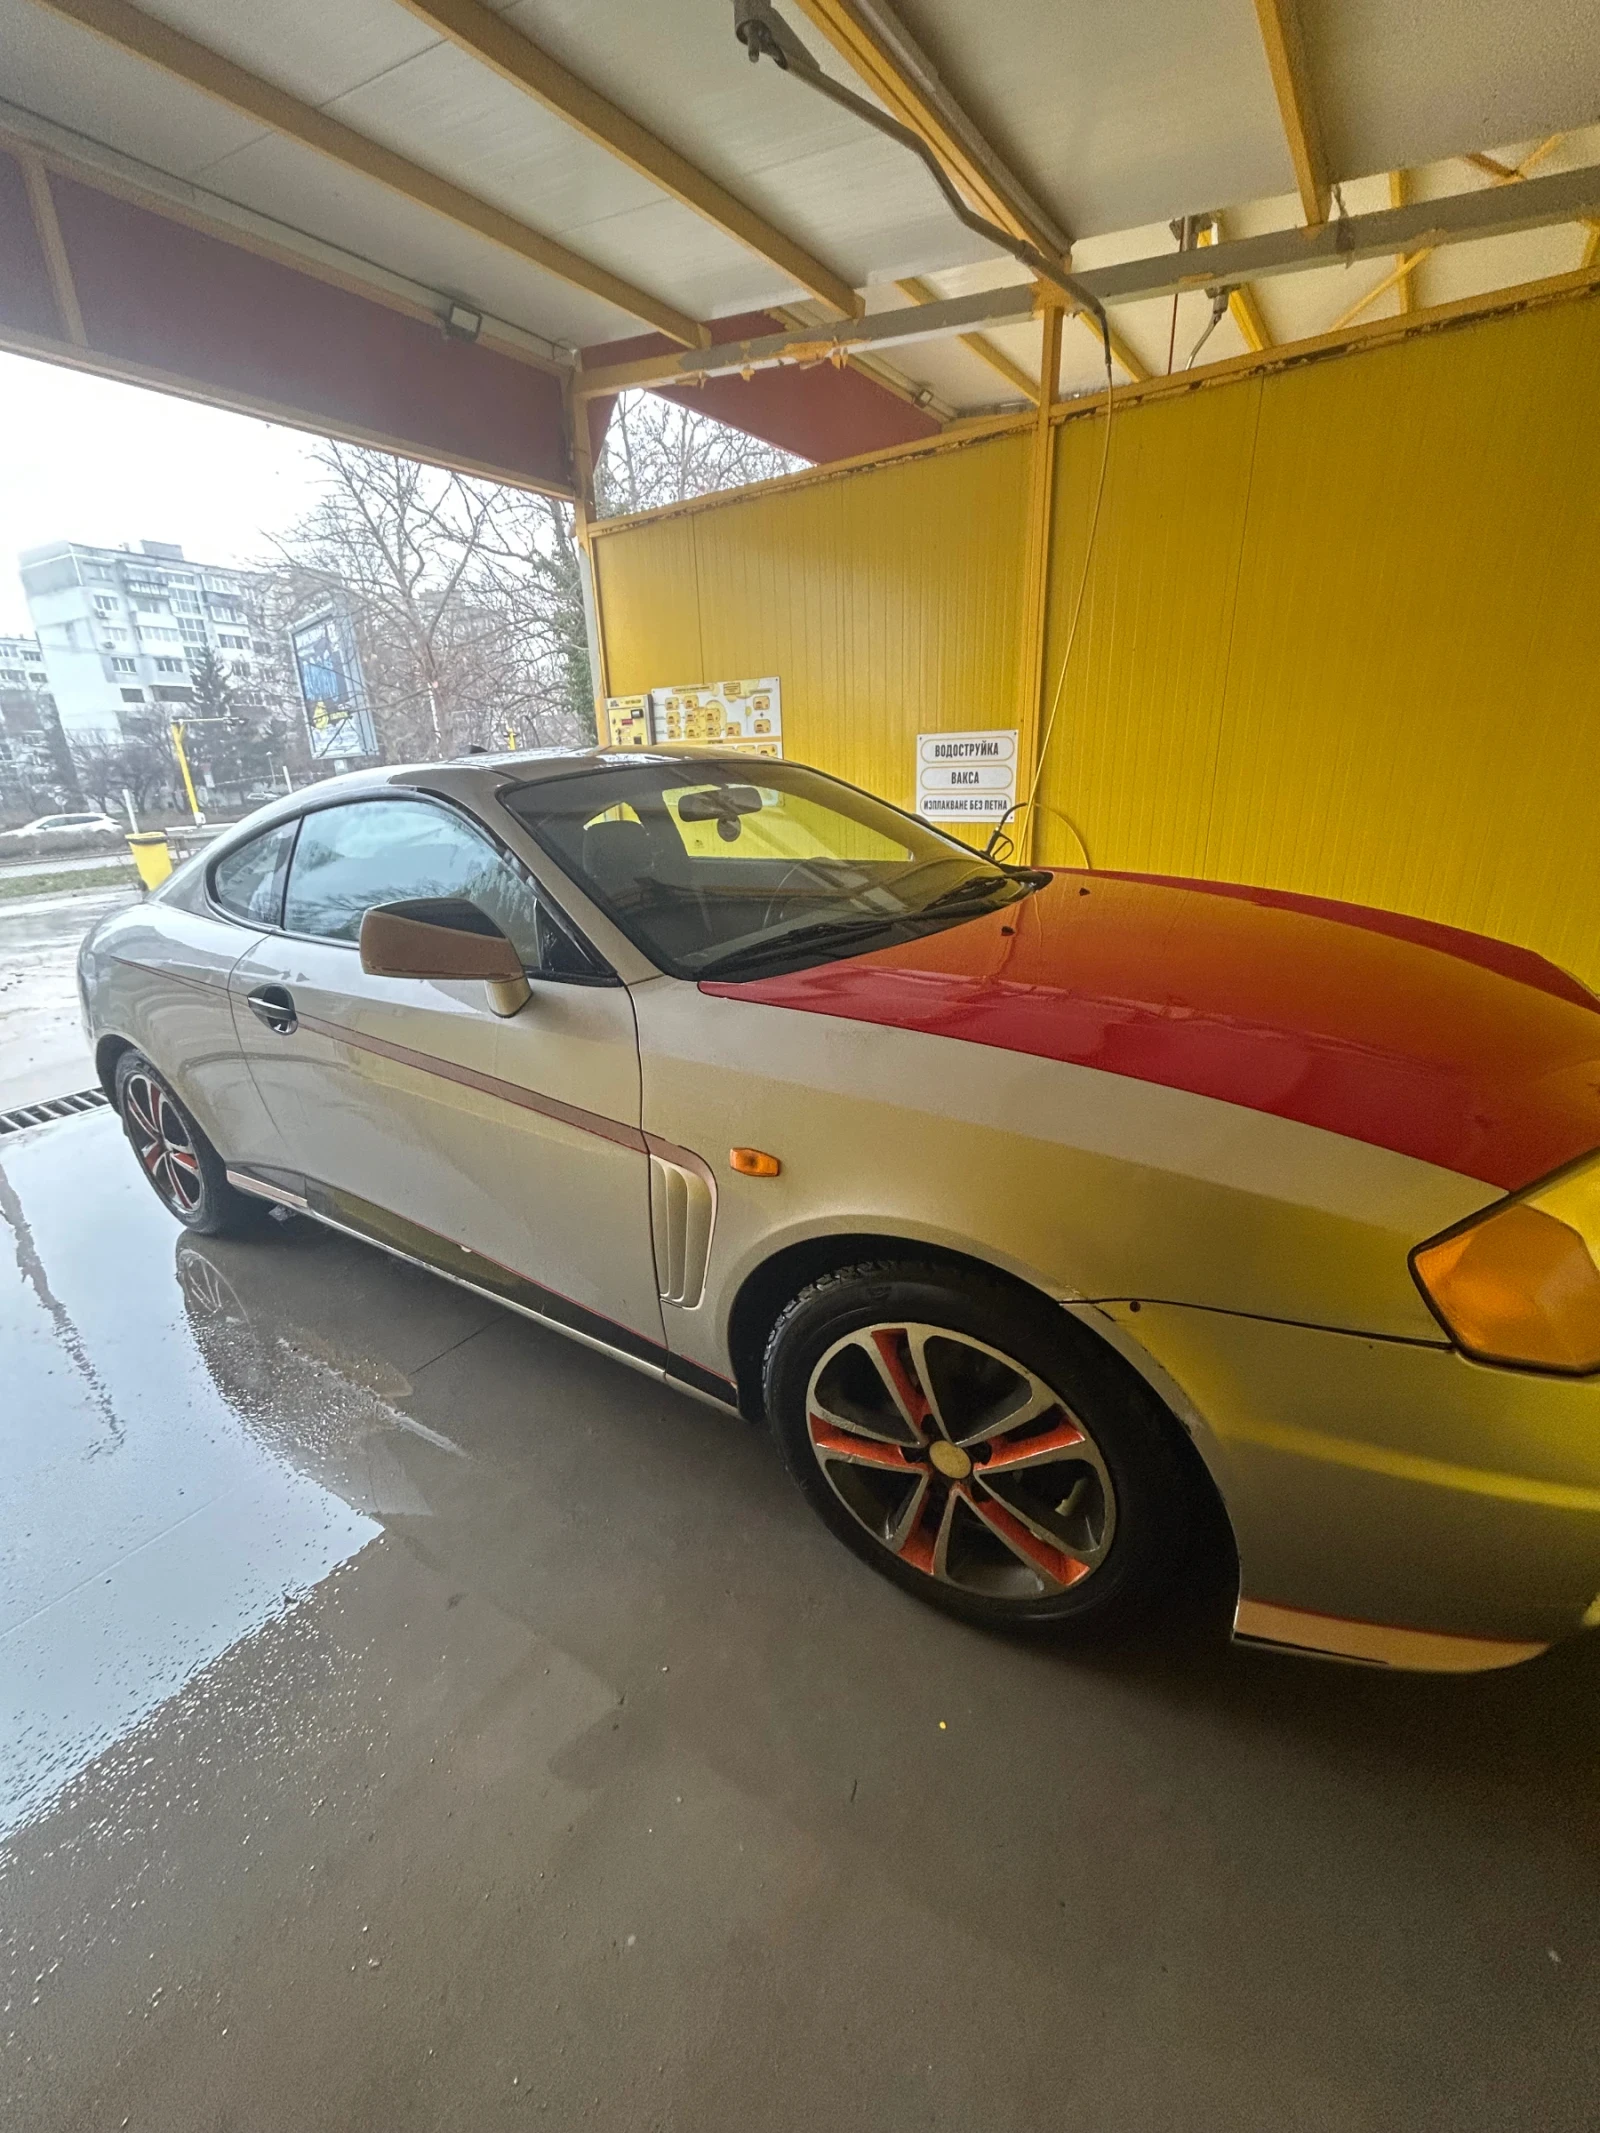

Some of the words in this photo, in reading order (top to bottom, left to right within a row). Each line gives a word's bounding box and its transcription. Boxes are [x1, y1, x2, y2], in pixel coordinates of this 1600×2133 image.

[935, 740, 999, 758] ВОДОСТРУЙКА
[951, 771, 979, 784] ВАКСА
[923, 800, 968, 810] ИЗПЛАКВАНЕ
[969, 800, 983, 810] БЕЗ
[984, 800, 1008, 810] ПЕТНА
